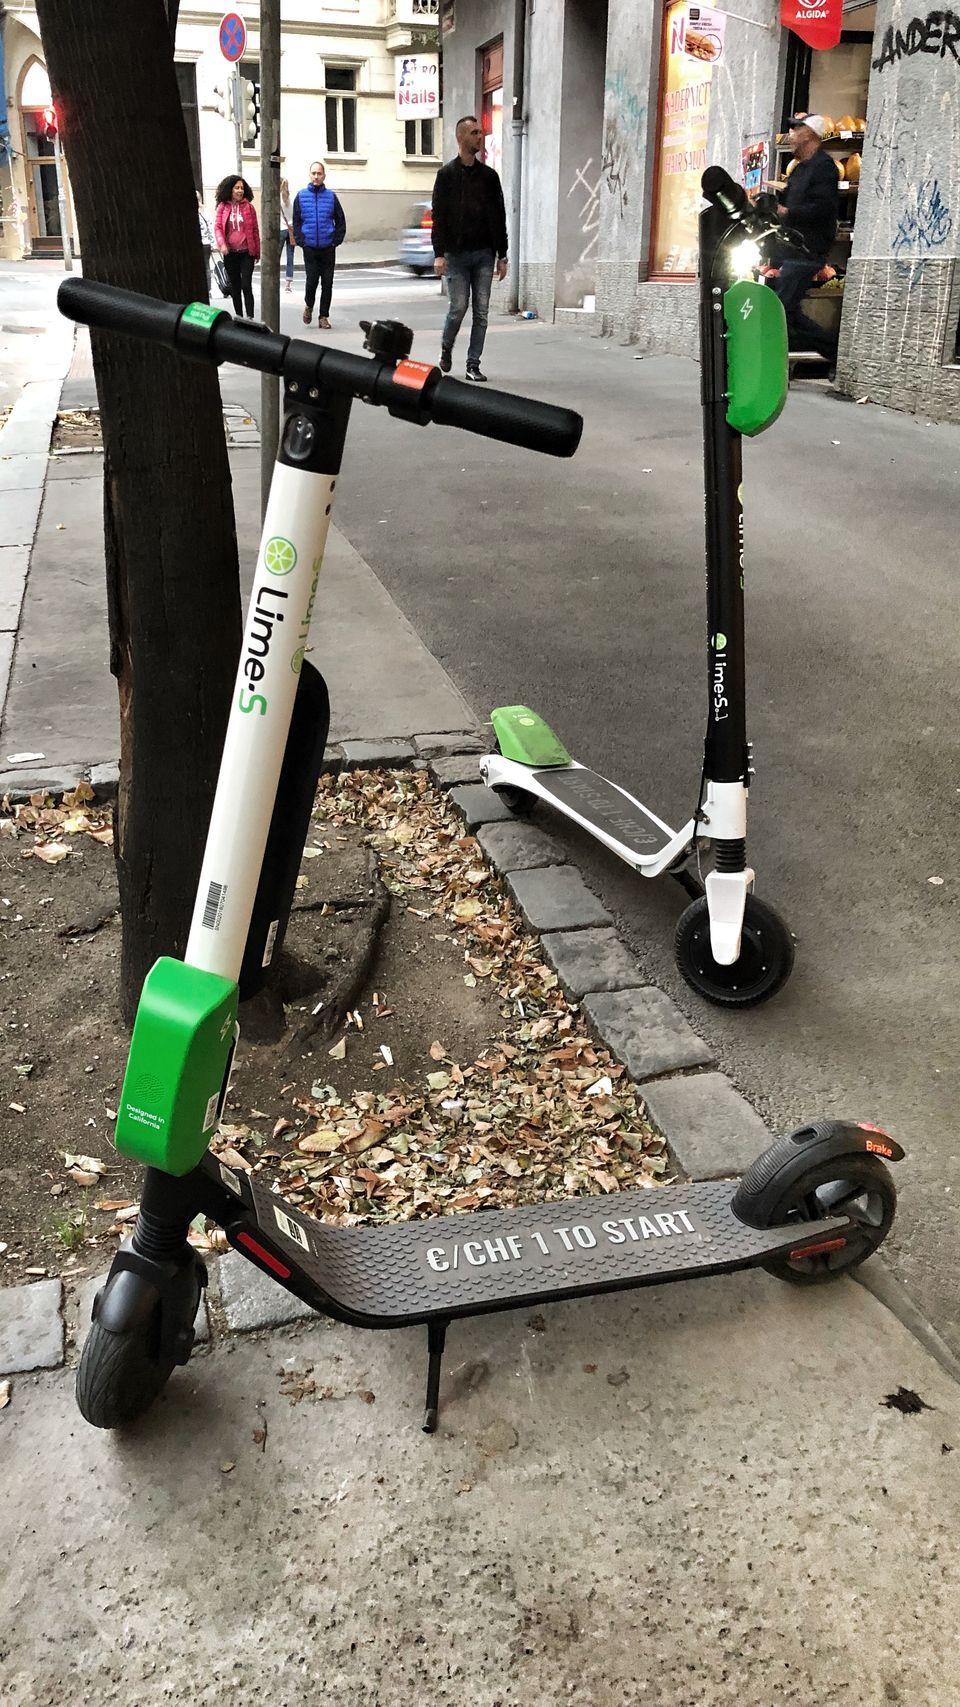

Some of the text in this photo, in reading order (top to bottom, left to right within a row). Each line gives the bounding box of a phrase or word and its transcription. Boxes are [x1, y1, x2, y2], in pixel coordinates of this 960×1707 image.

[795, 10, 827, 19] ALGIDA
[398, 89, 436, 105] Nails
[126, 1104, 165, 1124] Designed in
[128, 1112, 161, 1130] California
[865, 1140, 893, 1157] Brake
[426, 1209, 697, 1273] €/CHF 1 TO START
